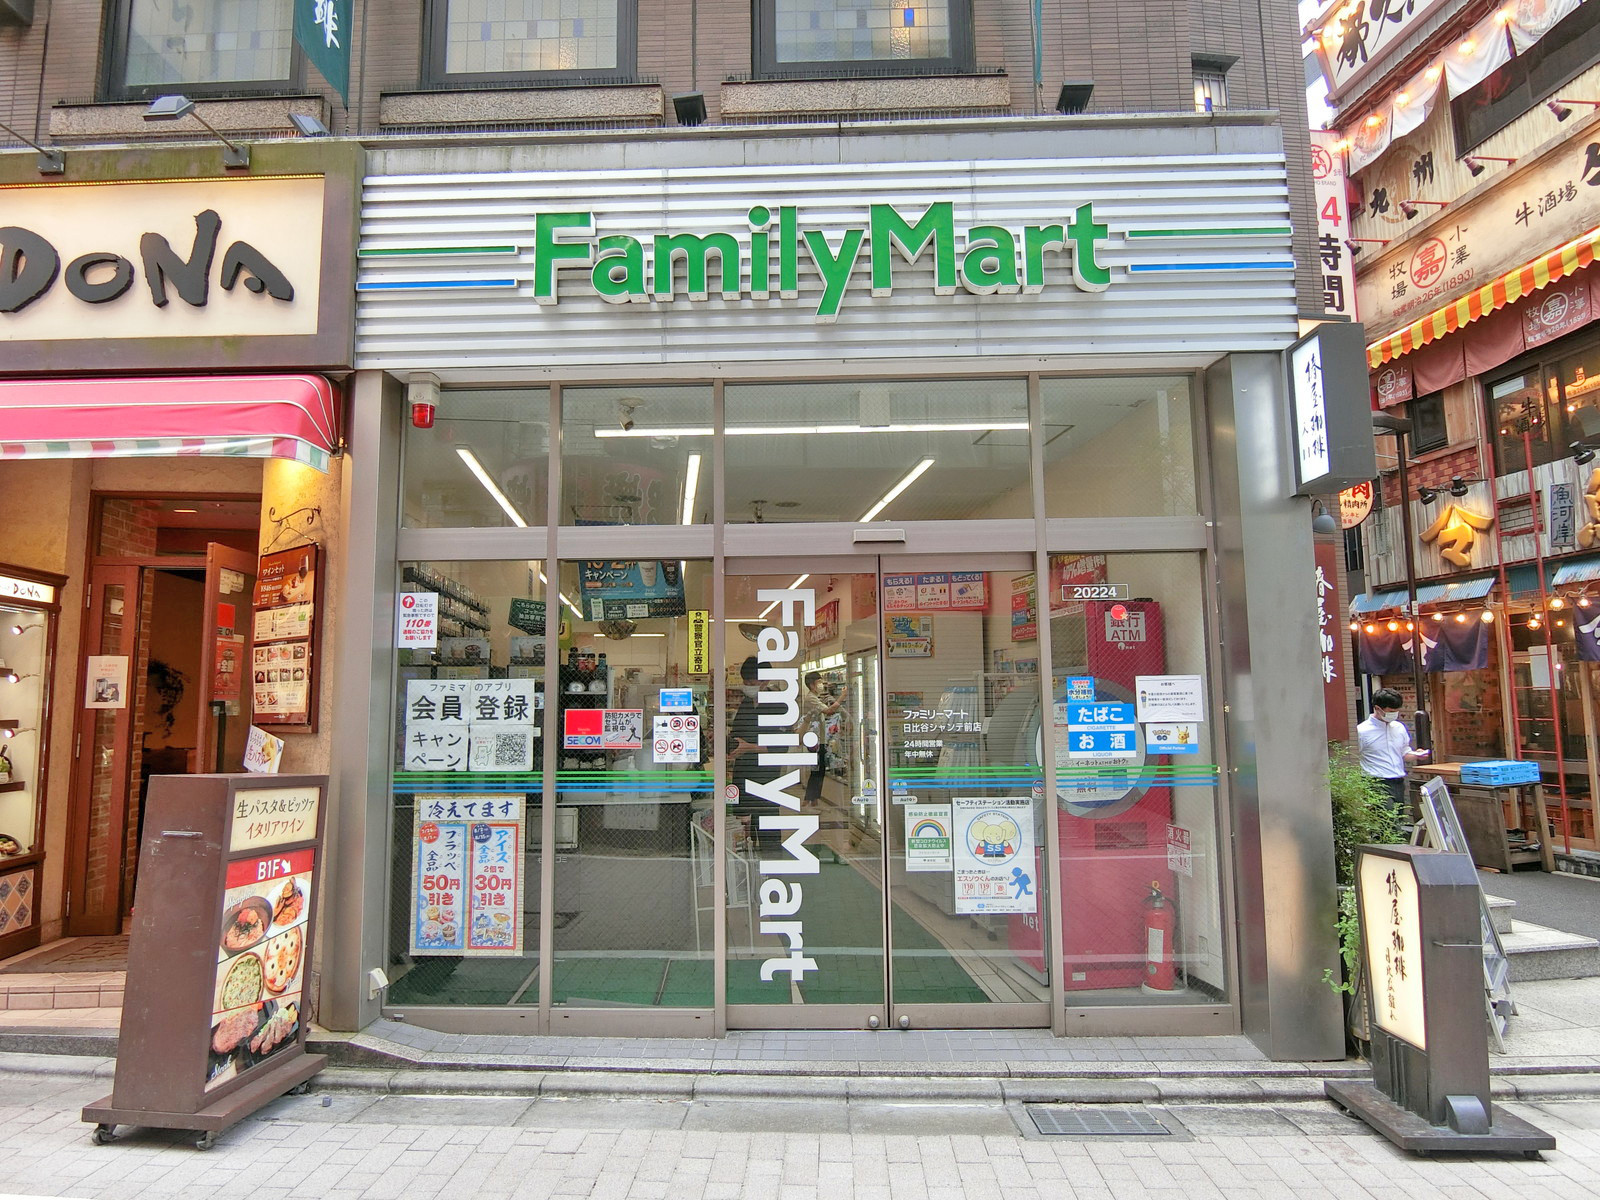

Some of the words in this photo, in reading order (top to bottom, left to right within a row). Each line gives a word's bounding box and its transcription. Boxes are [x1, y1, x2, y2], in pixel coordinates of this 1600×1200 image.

[1515, 180, 1578, 227] 牛酒場
[533, 201, 1112, 325] FamilyMart
[1552, 486, 1574, 543] 魚河岸
[584, 569, 628, 580] キャンペーン
[1073, 587, 1118, 599] 20224
[1110, 629, 1141, 641] ATM
[903, 709, 969, 719] ファミリーマート
[1077, 706, 1124, 722] たばこ
[903, 722, 982, 733] 日比谷シャンテ前店
[412, 731, 462, 748] キャン
[567, 736, 601, 745] SECOM
[904, 740, 943, 748] 24時間営業
[411, 752, 461, 768] ペーン
[904, 750, 934, 758] 年中無休
[744, 588, 820, 982] FamilyMart
[236, 797, 315, 819] 生パスタ&ピッツァ
[427, 801, 514, 819] 冷えてます
[246, 818, 305, 840] イタリアワイン
[444, 830, 457, 871] フラッペ
[478, 845, 491, 864] 全品
[495, 830, 509, 863] アイス
[257, 858, 281, 881] B1F
[426, 850, 439, 872] 全品
[423, 874, 460, 891] 50円
[474, 874, 512, 891] 30円
[428, 893, 454, 906] 引き
[480, 893, 506, 906] 引き
[1386, 868, 1408, 982] 椿屋珈琲
